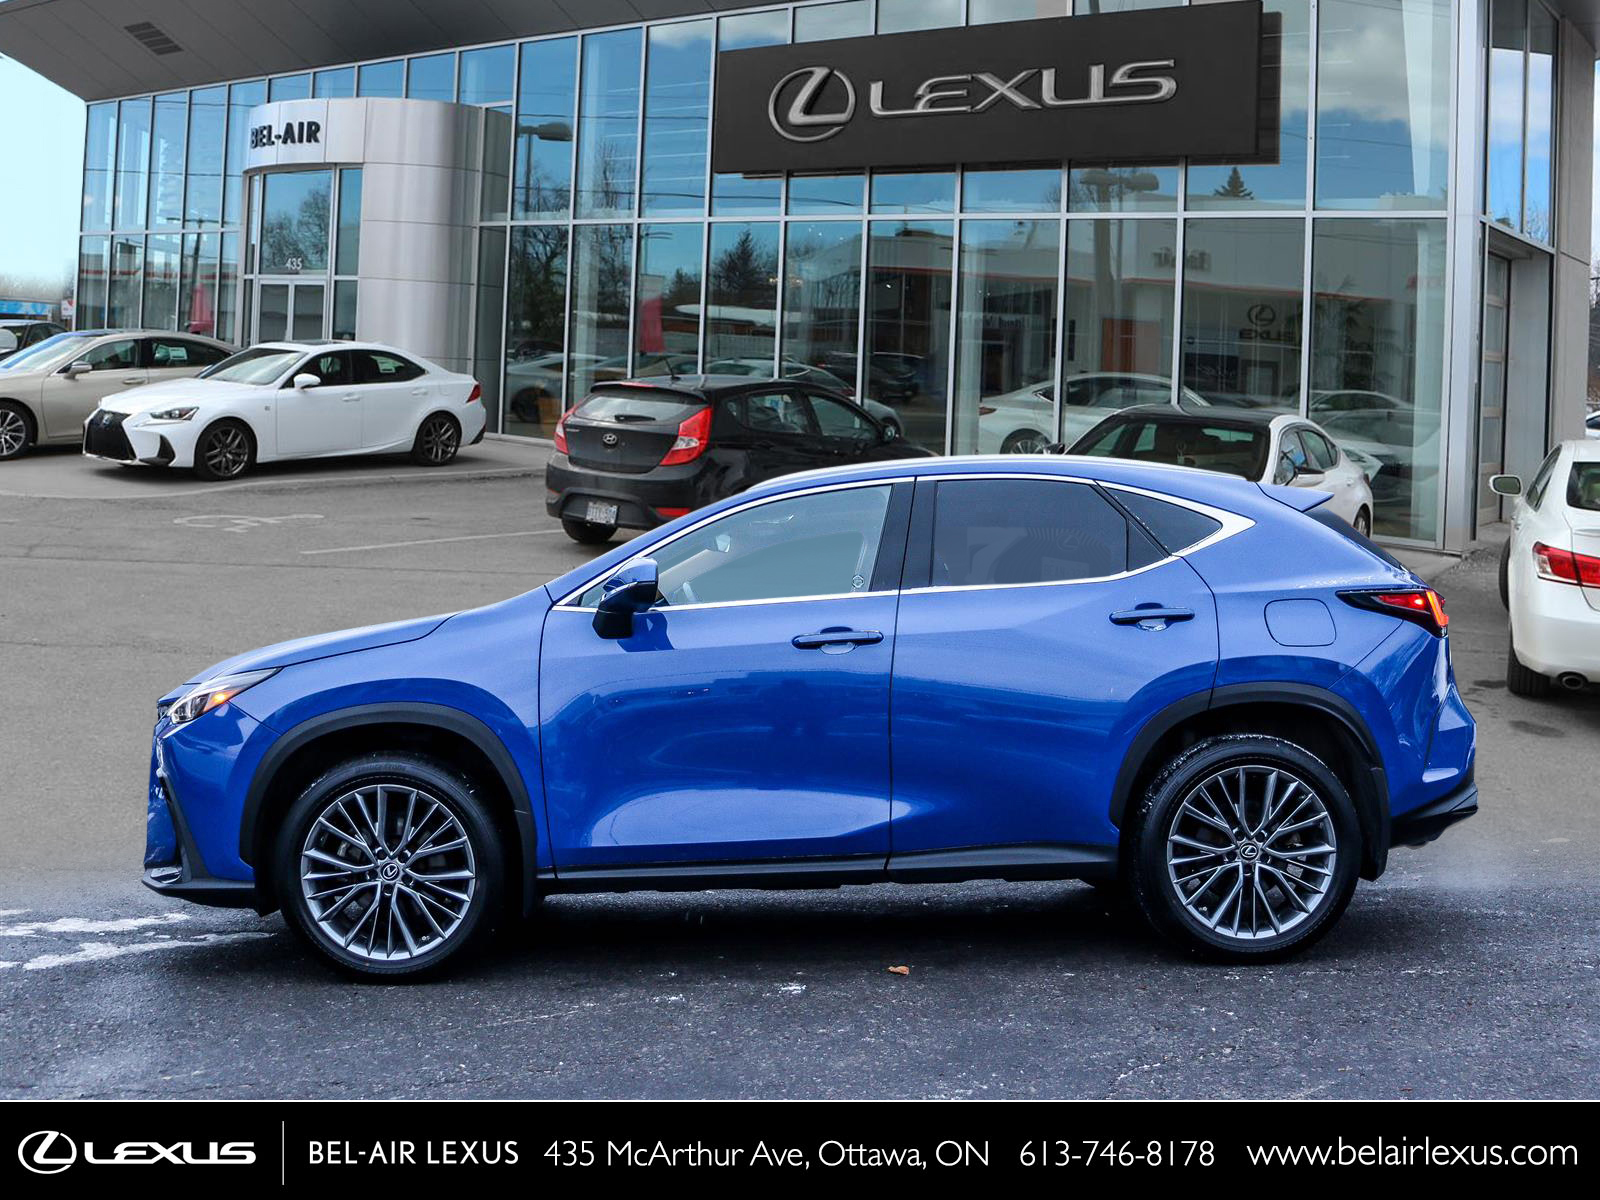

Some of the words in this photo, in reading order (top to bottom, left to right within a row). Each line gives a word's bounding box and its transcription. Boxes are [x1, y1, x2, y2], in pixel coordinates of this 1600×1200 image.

[868, 58, 1179, 117] LEXUS
[250, 120, 321, 149] BEL-AIR
[285, 257, 303, 271] 435
